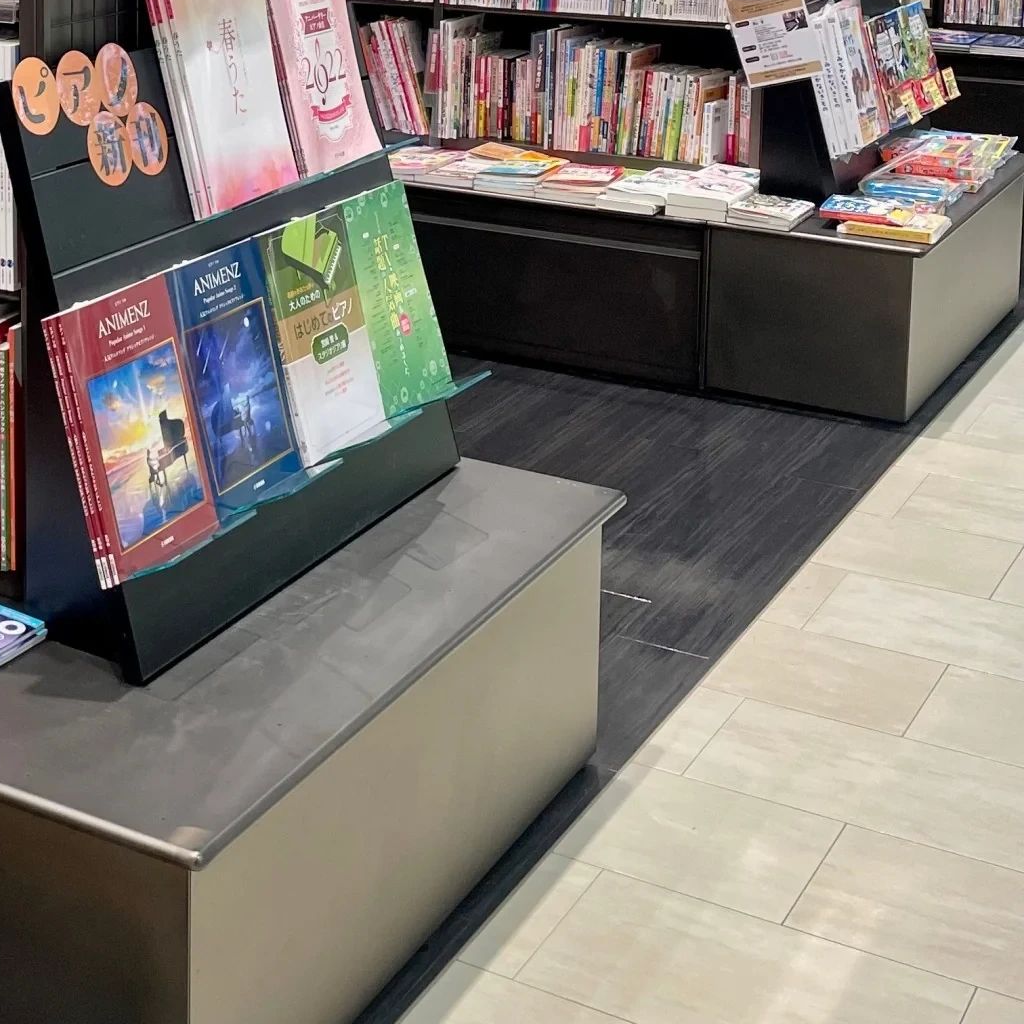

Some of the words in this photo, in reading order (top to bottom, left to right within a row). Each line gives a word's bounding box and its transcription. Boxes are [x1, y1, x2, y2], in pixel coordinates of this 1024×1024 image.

[15, 56, 131, 126] ピアノ
[193, 261, 242, 298] ANIMENZ
[97, 299, 152, 340] ANIMENZ
